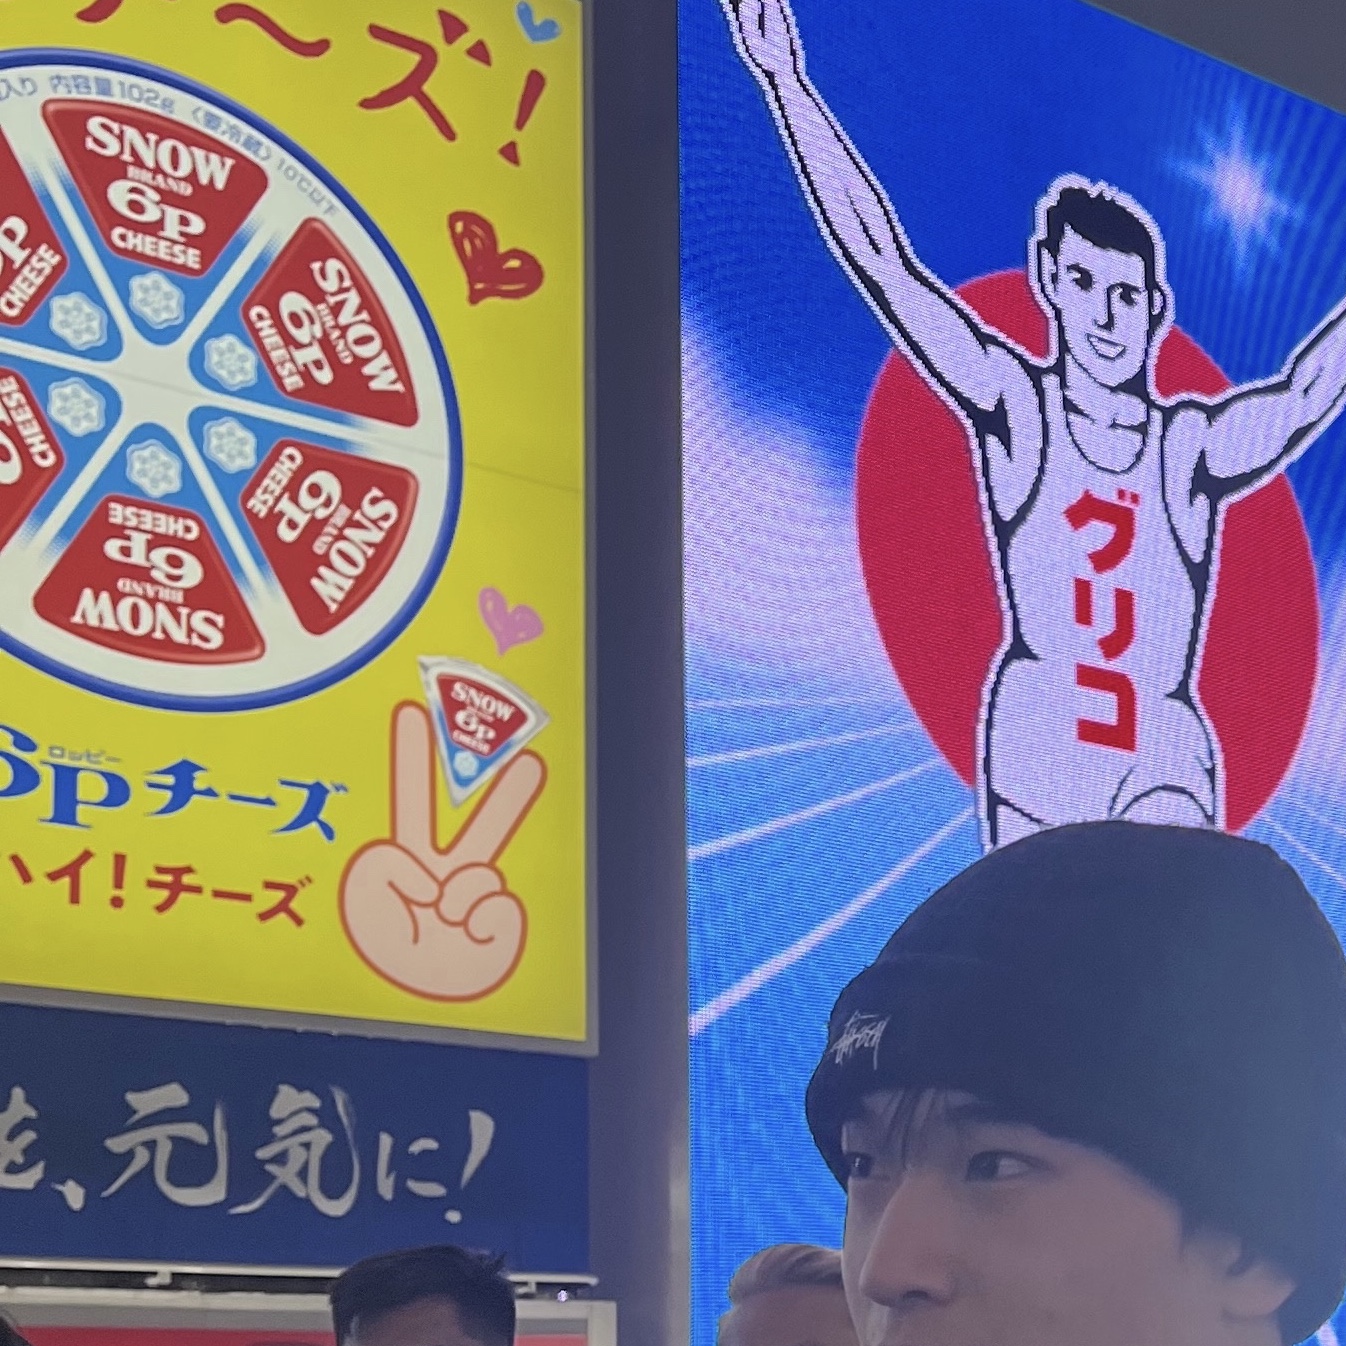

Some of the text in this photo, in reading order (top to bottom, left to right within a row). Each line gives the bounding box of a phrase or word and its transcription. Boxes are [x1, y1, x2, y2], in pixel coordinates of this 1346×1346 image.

[85, 115, 236, 191] SNOW
[126, 164, 194, 197] BRAND
[106, 178, 207, 243] 6P
[0, 243, 62, 318] CHEESE
[110, 226, 202, 270] CHEESE
[248, 304, 304, 393] CHEESE
[278, 290, 335, 386] 6P
[309, 257, 406, 394] SNOW
[315, 302, 354, 365] BRAND
[246, 446, 304, 519] CHEESE
[273, 469, 343, 544] 6P
[108, 501, 201, 542] CHEESE
[310, 486, 400, 615] SNOW
[102, 528, 205, 590] 6P
[70, 586, 226, 651] SNOW
[1062, 487, 1141, 754] グリコ
[451, 681, 517, 723] SNOW
